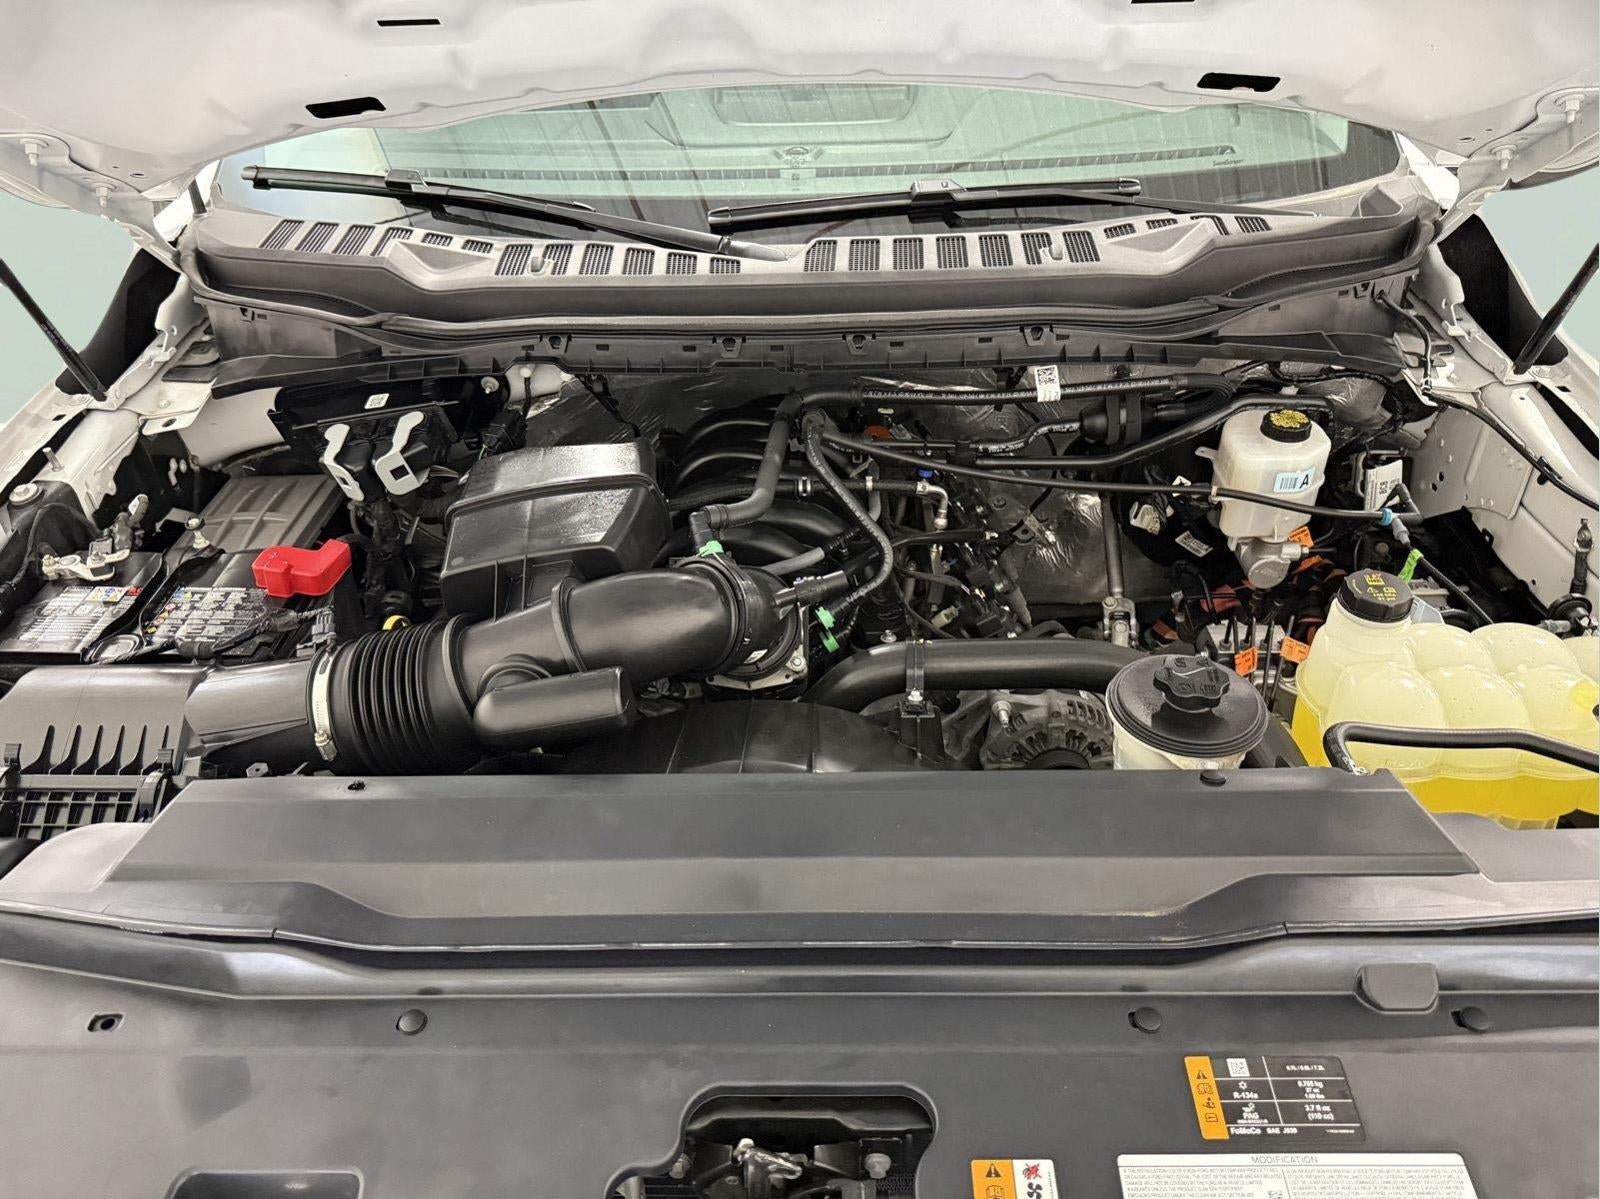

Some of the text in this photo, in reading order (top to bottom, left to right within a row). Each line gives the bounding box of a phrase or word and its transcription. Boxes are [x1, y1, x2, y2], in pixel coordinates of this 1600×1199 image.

[1299, 473, 1309, 489] A
[1232, 1091, 1259, 1099] R-134a
[1323, 1112, 1335, 1121] cc)
[1250, 1155, 1318, 1164] MODIFICATION
